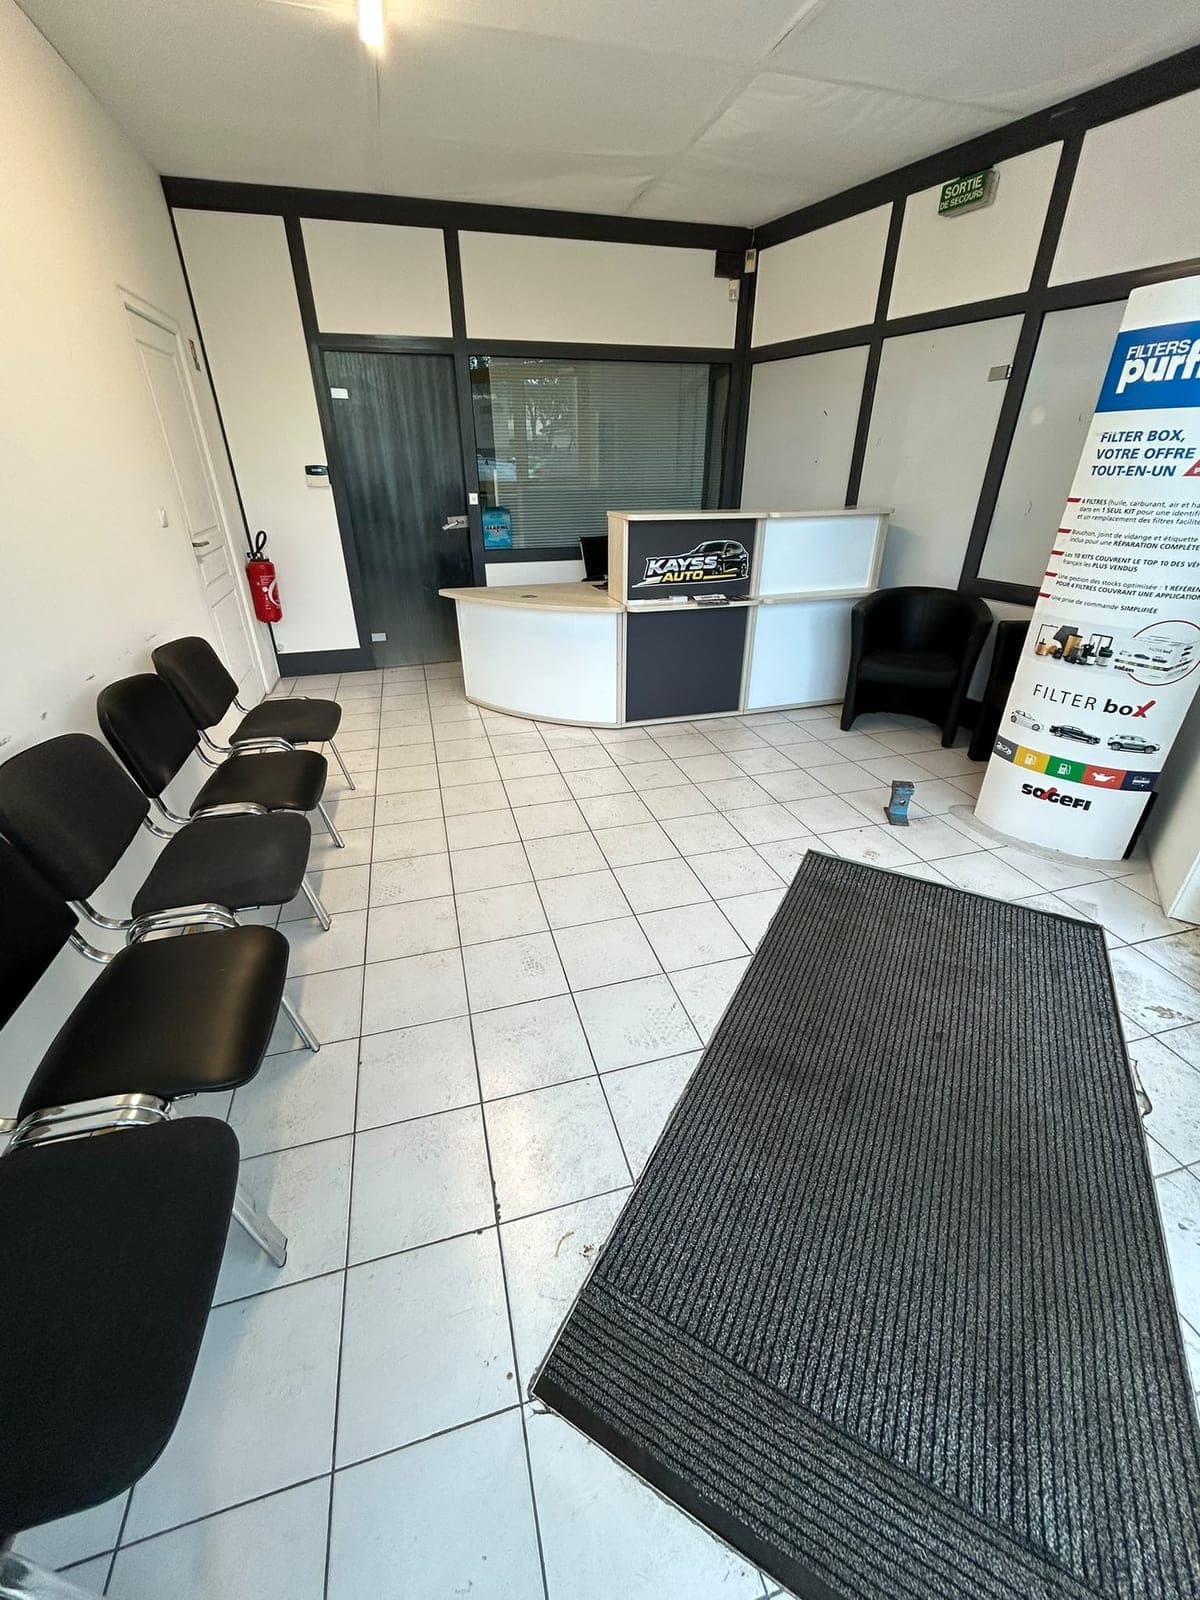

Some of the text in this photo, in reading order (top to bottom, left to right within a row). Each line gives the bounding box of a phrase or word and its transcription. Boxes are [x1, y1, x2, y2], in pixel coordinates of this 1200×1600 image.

[944, 174, 983, 199] SORTIE
[940, 188, 984, 210] DE SECOURS
[1126, 339, 1192, 360] FILTERS
[1100, 429, 1185, 443] FILTER BOX,
[1097, 447, 1197, 459] VOTRE OFFRE
[1091, 465, 1177, 477] TOUT-EN-UN
[1129, 500, 1166, 508] carburant,
[1092, 515, 1136, 523] remplacement
[1153, 517, 1173, 525] filtres
[1113, 540, 1158, 549] RÉPARATION
[1163, 535, 1198, 543] étiquette
[1095, 554, 1131, 563] COUVRENT
[646, 556, 718, 576] KAYSS
[1110, 564, 1138, 572] VENDUS
[661, 570, 704, 583] AUTO
[1075, 583, 1096, 591] FILTRES
[1098, 586, 1137, 596] COUVRANT
[1123, 582, 1158, 590] optimisée
[1084, 601, 1118, 610] commande
[1120, 604, 1158, 614] SIMPLIFIÉE
[1032, 683, 1097, 711] FILTER
